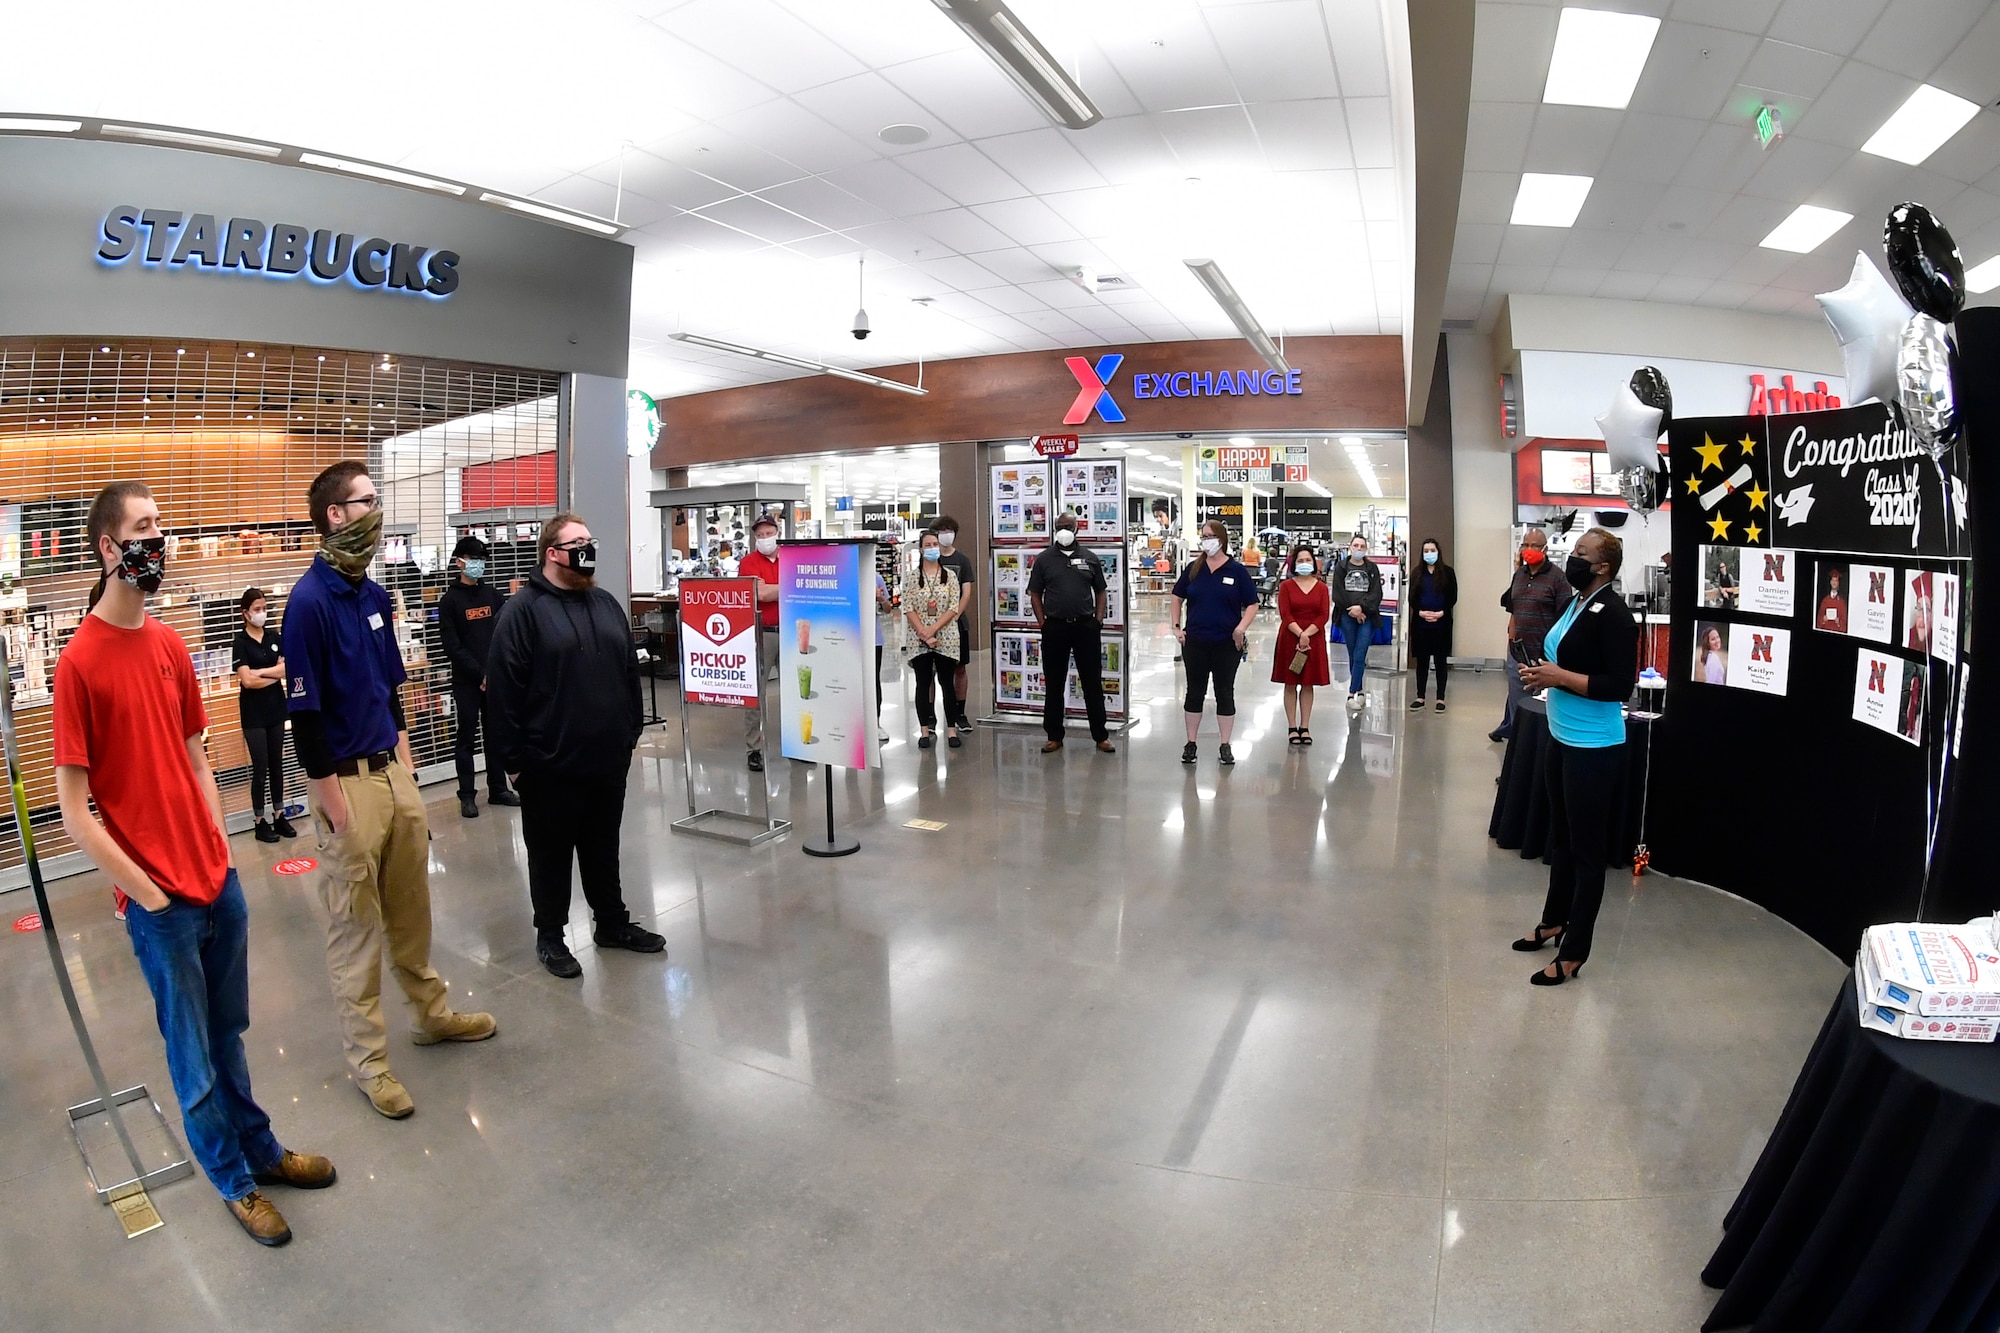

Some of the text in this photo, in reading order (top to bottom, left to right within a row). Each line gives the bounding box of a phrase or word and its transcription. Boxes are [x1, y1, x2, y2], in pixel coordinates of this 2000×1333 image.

[98, 204, 461, 296] STARBUCKS
[1134, 368, 1303, 399] EXCHANGE
[1040, 438, 1068, 446] WEEKLY
[1043, 445, 1066, 454] SALES
[1221, 448, 1268, 467] HAPPY
[1288, 454, 1306, 464] JUNE
[1220, 469, 1270, 482] DAD'S DAY
[1290, 466, 1304, 481] 21
[1864, 462, 1921, 501] Class of
[1197, 504, 1244, 515] werzon
[1869, 492, 1917, 526] 2020
[797, 564, 837, 575] TRIPLE SHOT
[795, 578, 838, 590] OF SUNSHINE
[1758, 585, 1790, 595] Damien
[1867, 608, 1886, 619] Gavin
[690, 652, 747, 669] PICKUP
[690, 667, 747, 681] CURBSIDE
[1747, 665, 1775, 676] Kaitlyn
[714, 681, 726, 689] SAFE
[698, 693, 746, 706] Now Available
[1866, 697, 1884, 708] Annie
[1920, 931, 1957, 985] FREE PIZZA
